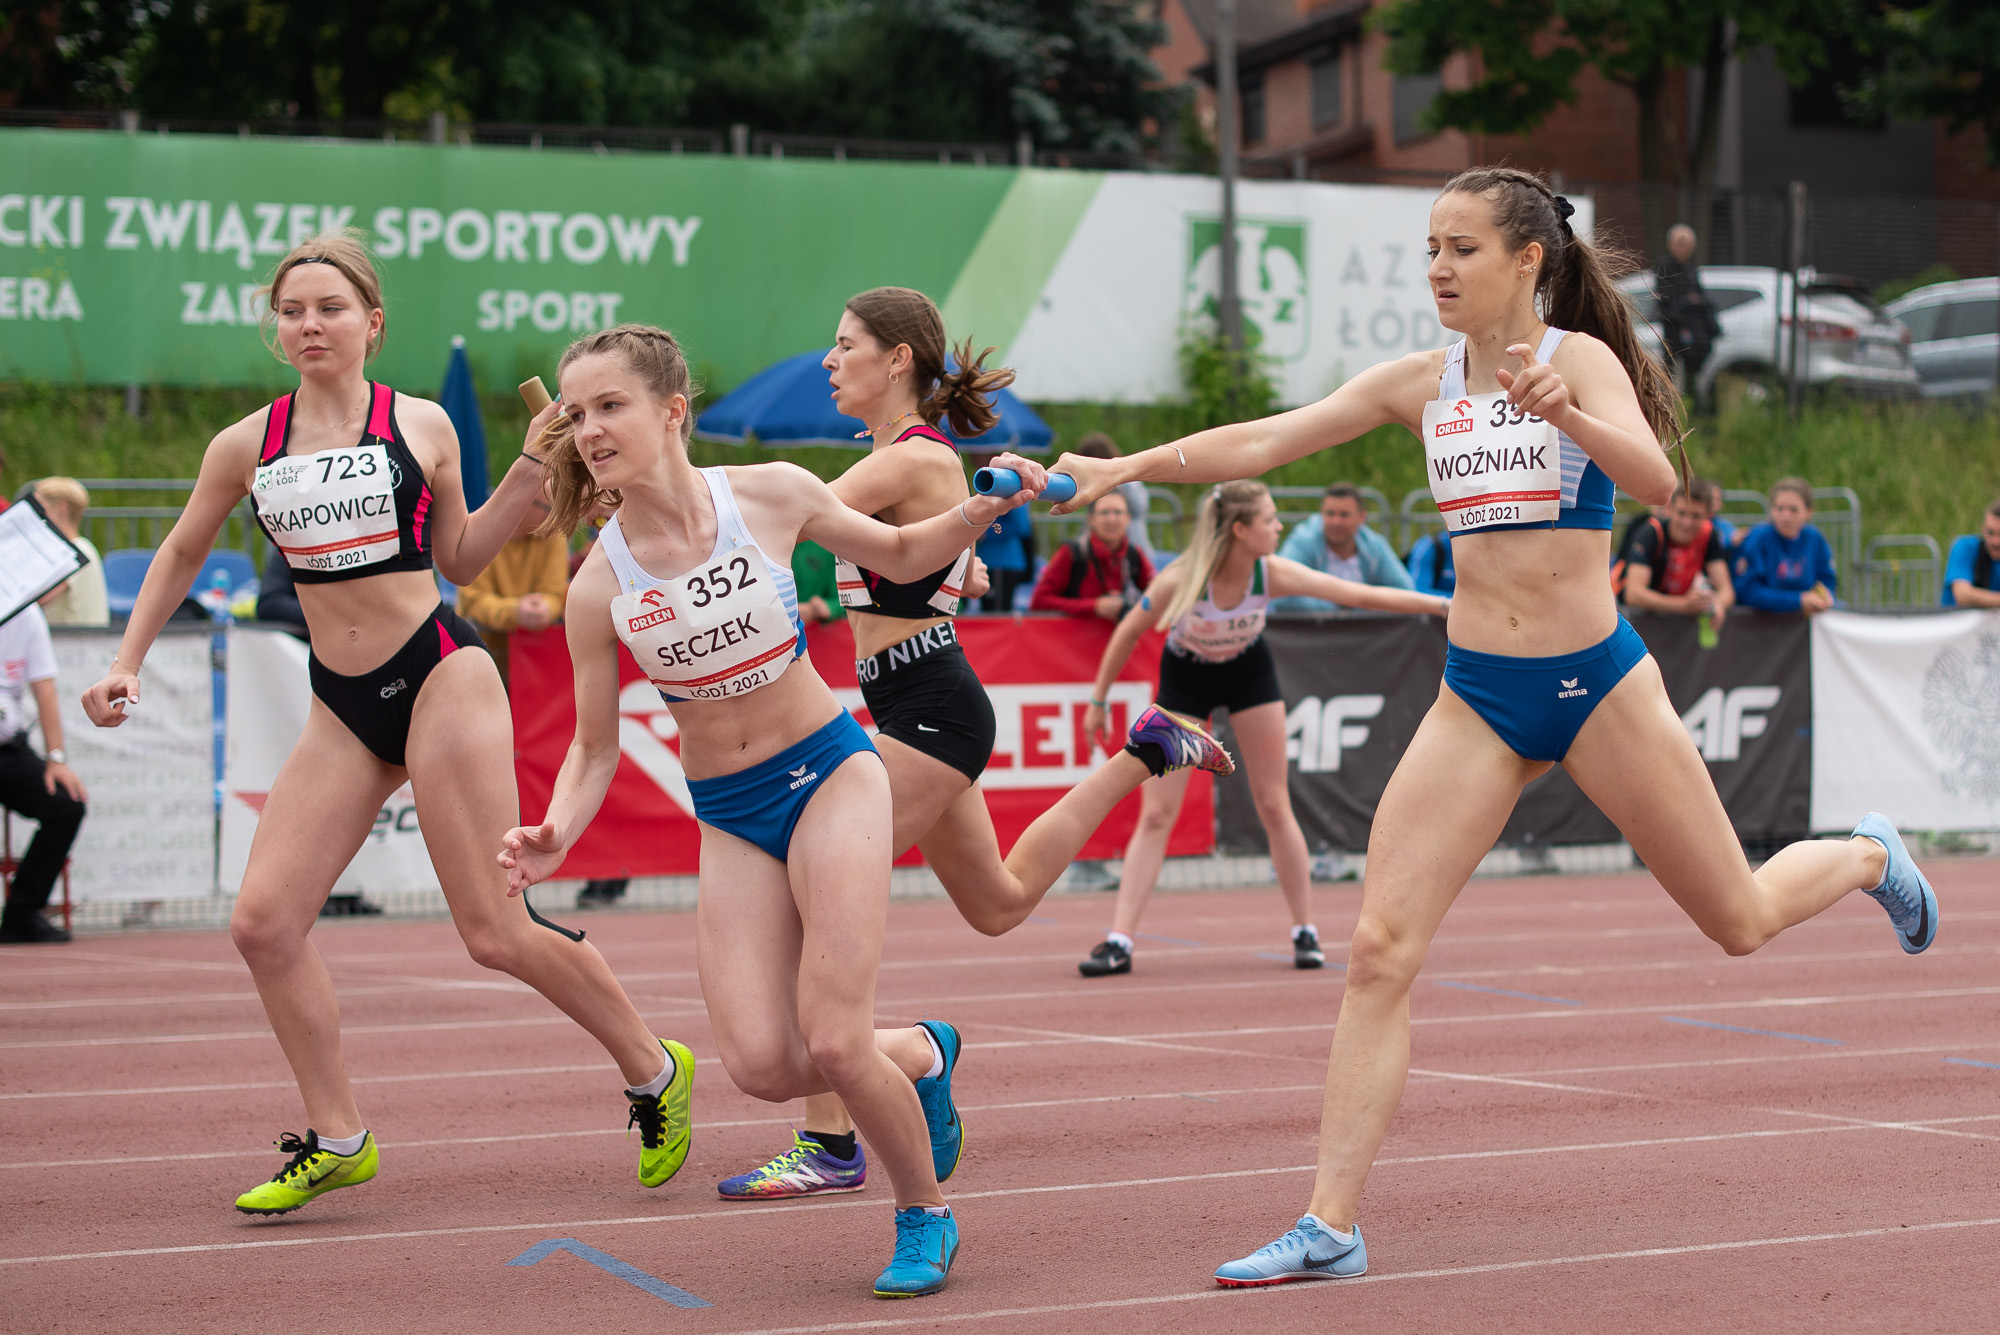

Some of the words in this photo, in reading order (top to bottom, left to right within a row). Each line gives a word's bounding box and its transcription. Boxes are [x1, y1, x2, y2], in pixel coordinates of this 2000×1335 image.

[0, 194, 84, 249] CKI
[105, 196, 356, 270] ZWIĄZEK
[373, 206, 702, 267] SPORTOWY
[1338, 243, 1431, 287] AZ
[0, 276, 84, 322] ERA
[181, 281, 270, 325] ZAB
[476, 289, 625, 333] SPORT
[1338, 297, 1461, 349] ŁÓD
[1437, 419, 1472, 436] ORLEN
[316, 453, 377, 483] 723
[1433, 445, 1547, 482] WOŹNIAK
[264, 493, 391, 533] SKAPOWICZ
[1460, 505, 1486, 526] ŁÓDŹ
[1489, 506, 1520, 521] 2021
[306, 553, 334, 569] ŁÓDŹ
[336, 550, 368, 567] 2021
[687, 557, 758, 608] 352
[631, 608, 673, 632] ORLEN
[1228, 613, 1259, 631] 167
[656, 611, 761, 667] SĘCZEK
[689, 682, 731, 699] ŁÓDŹ
[732, 670, 770, 694] 2021
[1558, 688, 1588, 699] erima
[789, 771, 818, 790] erima
